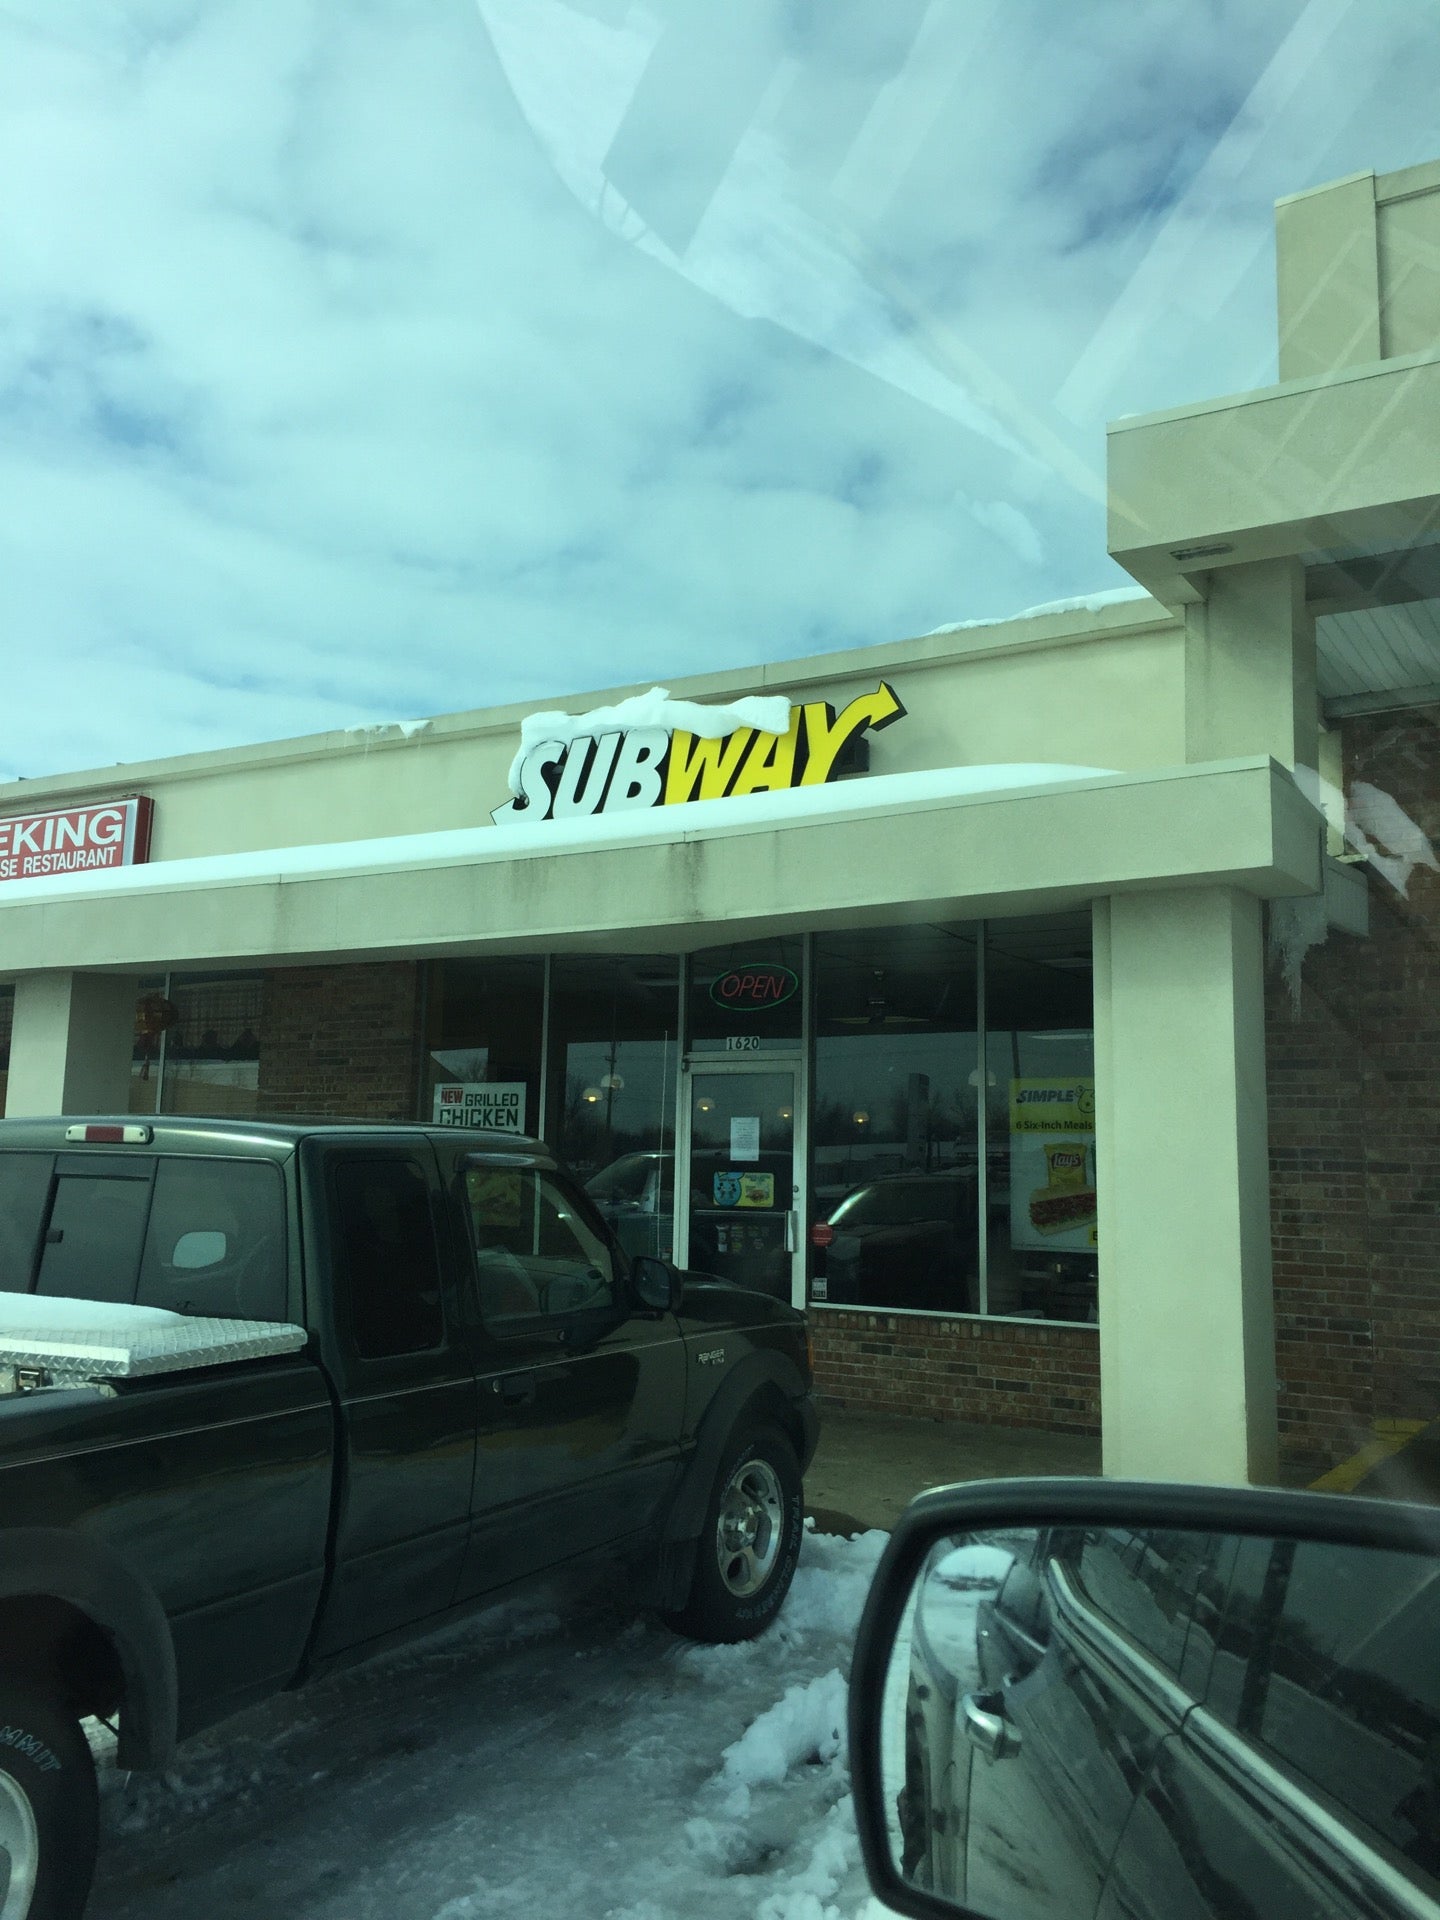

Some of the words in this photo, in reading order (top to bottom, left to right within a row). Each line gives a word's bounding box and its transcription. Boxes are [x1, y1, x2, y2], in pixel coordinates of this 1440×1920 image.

[490, 681, 903, 826] SUBWAY
[23, 846, 117, 875] RESTAURANT
[721, 975, 785, 998] OPEN
[727, 1037, 759, 1051] 1620
[441, 1090, 464, 1104] NEW
[465, 1093, 519, 1107] GRILLED
[1016, 1089, 1075, 1104] SIMPLE
[440, 1108, 518, 1127] CHICKEN
[1024, 1120, 1062, 1130] Six-Inch
[1064, 1120, 1093, 1130] Meals
